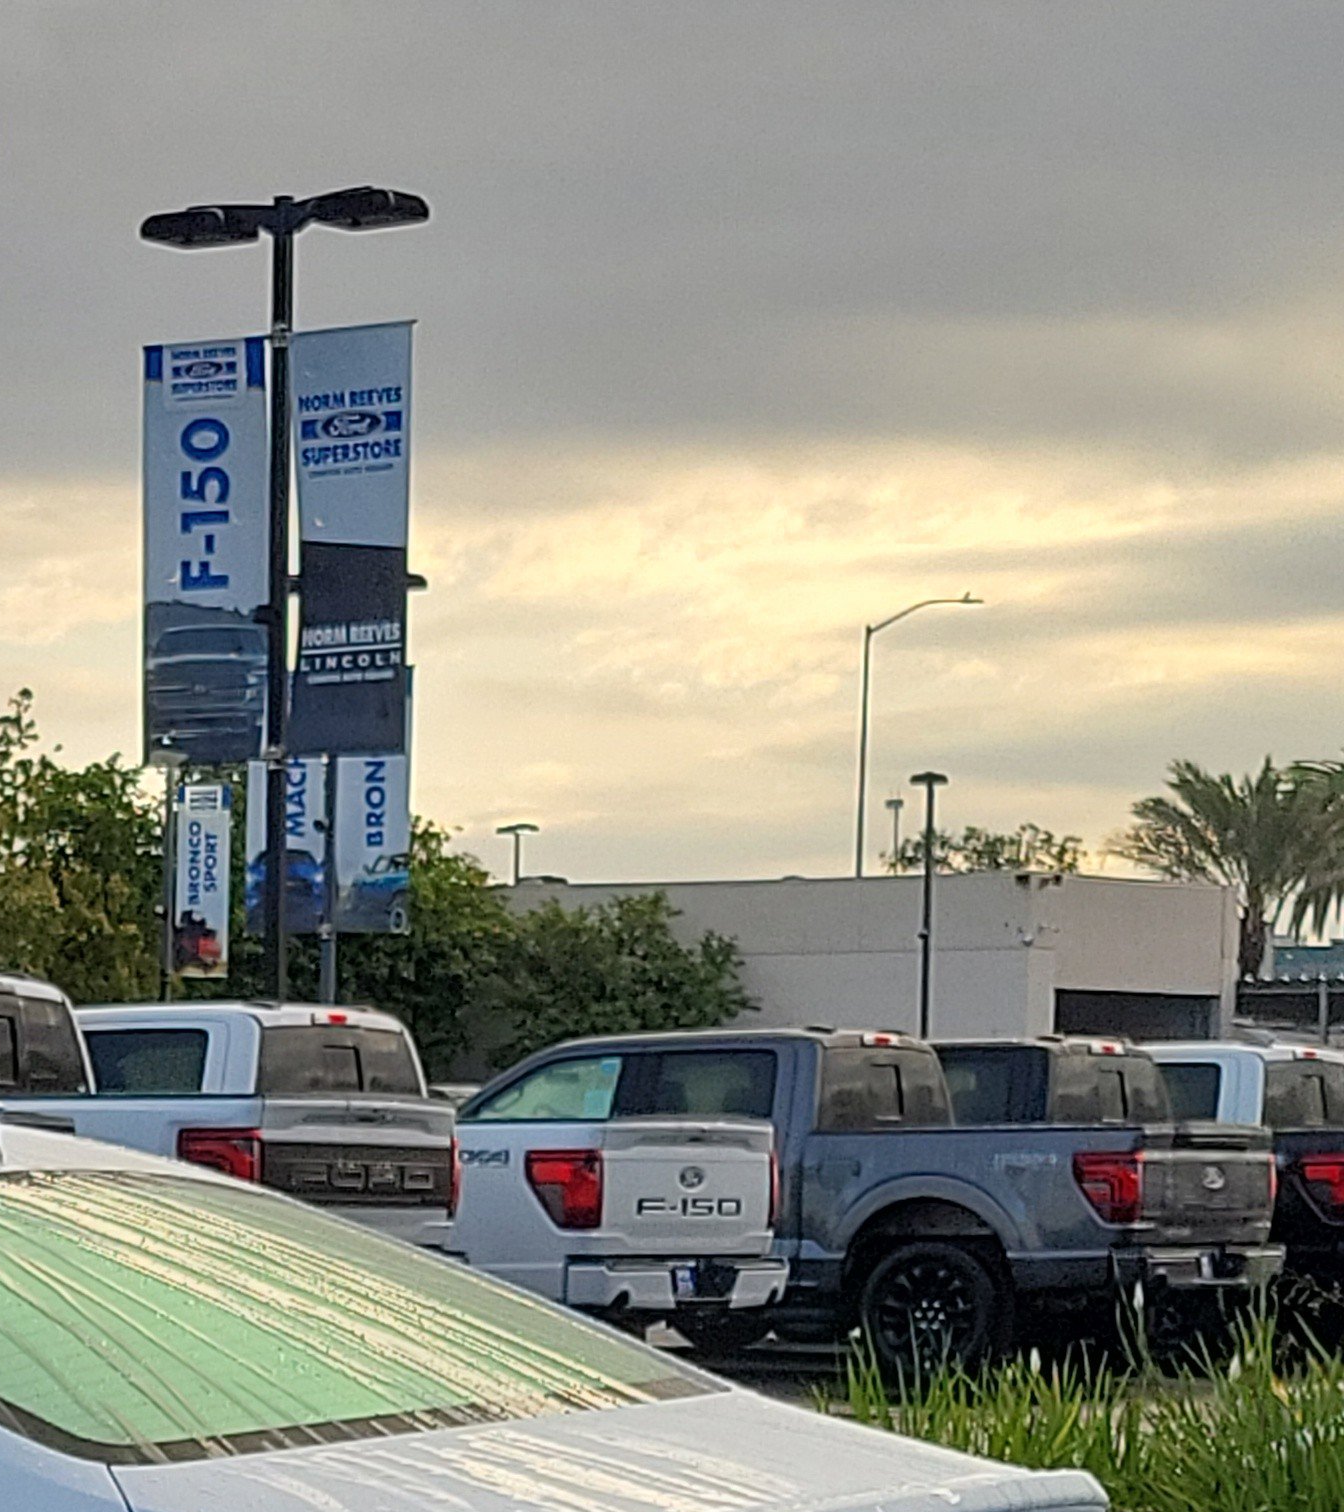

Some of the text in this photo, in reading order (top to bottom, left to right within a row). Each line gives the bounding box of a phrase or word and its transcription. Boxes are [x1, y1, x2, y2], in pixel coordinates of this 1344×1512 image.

[297, 387, 402, 413] NORM REEVES
[301, 438, 402, 467] SUPERSTORE
[180, 417, 230, 591] F-150
[301, 621, 402, 648] NORM REEVES
[299, 649, 402, 672] LINCOLN
[365, 760, 386, 847] BRON
[188, 821, 202, 905] BRONCO
[203, 831, 218, 892] SPORT
[459, 1150, 510, 1166] X4
[636, 1198, 742, 1217] F-150
